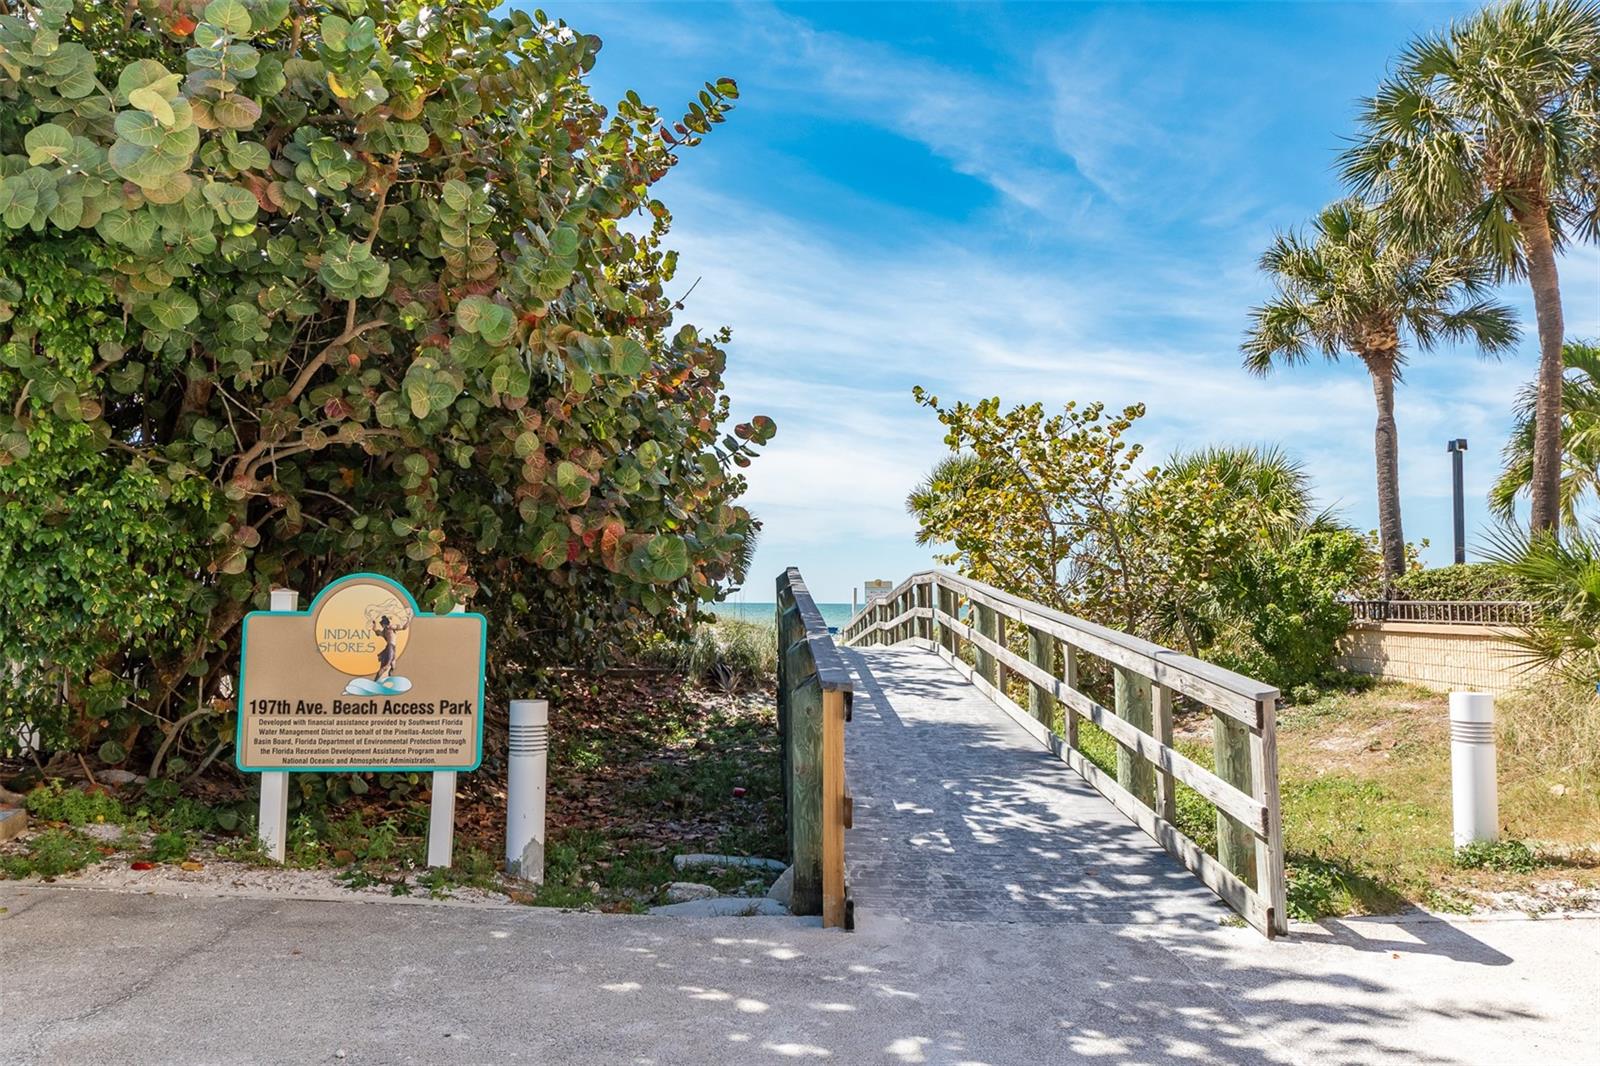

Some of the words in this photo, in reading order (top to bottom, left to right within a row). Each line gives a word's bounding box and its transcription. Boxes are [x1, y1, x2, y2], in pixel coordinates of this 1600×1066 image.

[324, 628, 371, 639] INDIAN
[319, 643, 375, 653] SHORES
[250, 700, 290, 715] 197th
[295, 700, 327, 715] Ave.
[333, 700, 377, 715] Beach
[382, 700, 434, 715] Access
[440, 700, 472, 715] Park
[259, 718, 291, 727] Developed
[279, 728, 319, 736] Management
[321, 728, 343, 736] District
[446, 728, 462, 736] River
[273, 738, 293, 746] Board,
[295, 738, 316, 746] Florida
[318, 738, 354, 746] Department
[356, 738, 362, 746] of
[364, 738, 408, 746] Environmental
[443, 738, 466, 746] through
[331, 748, 371, 756] Development
[408, 748, 434, 756] Program
[310, 756, 334, 764] Oceanic
